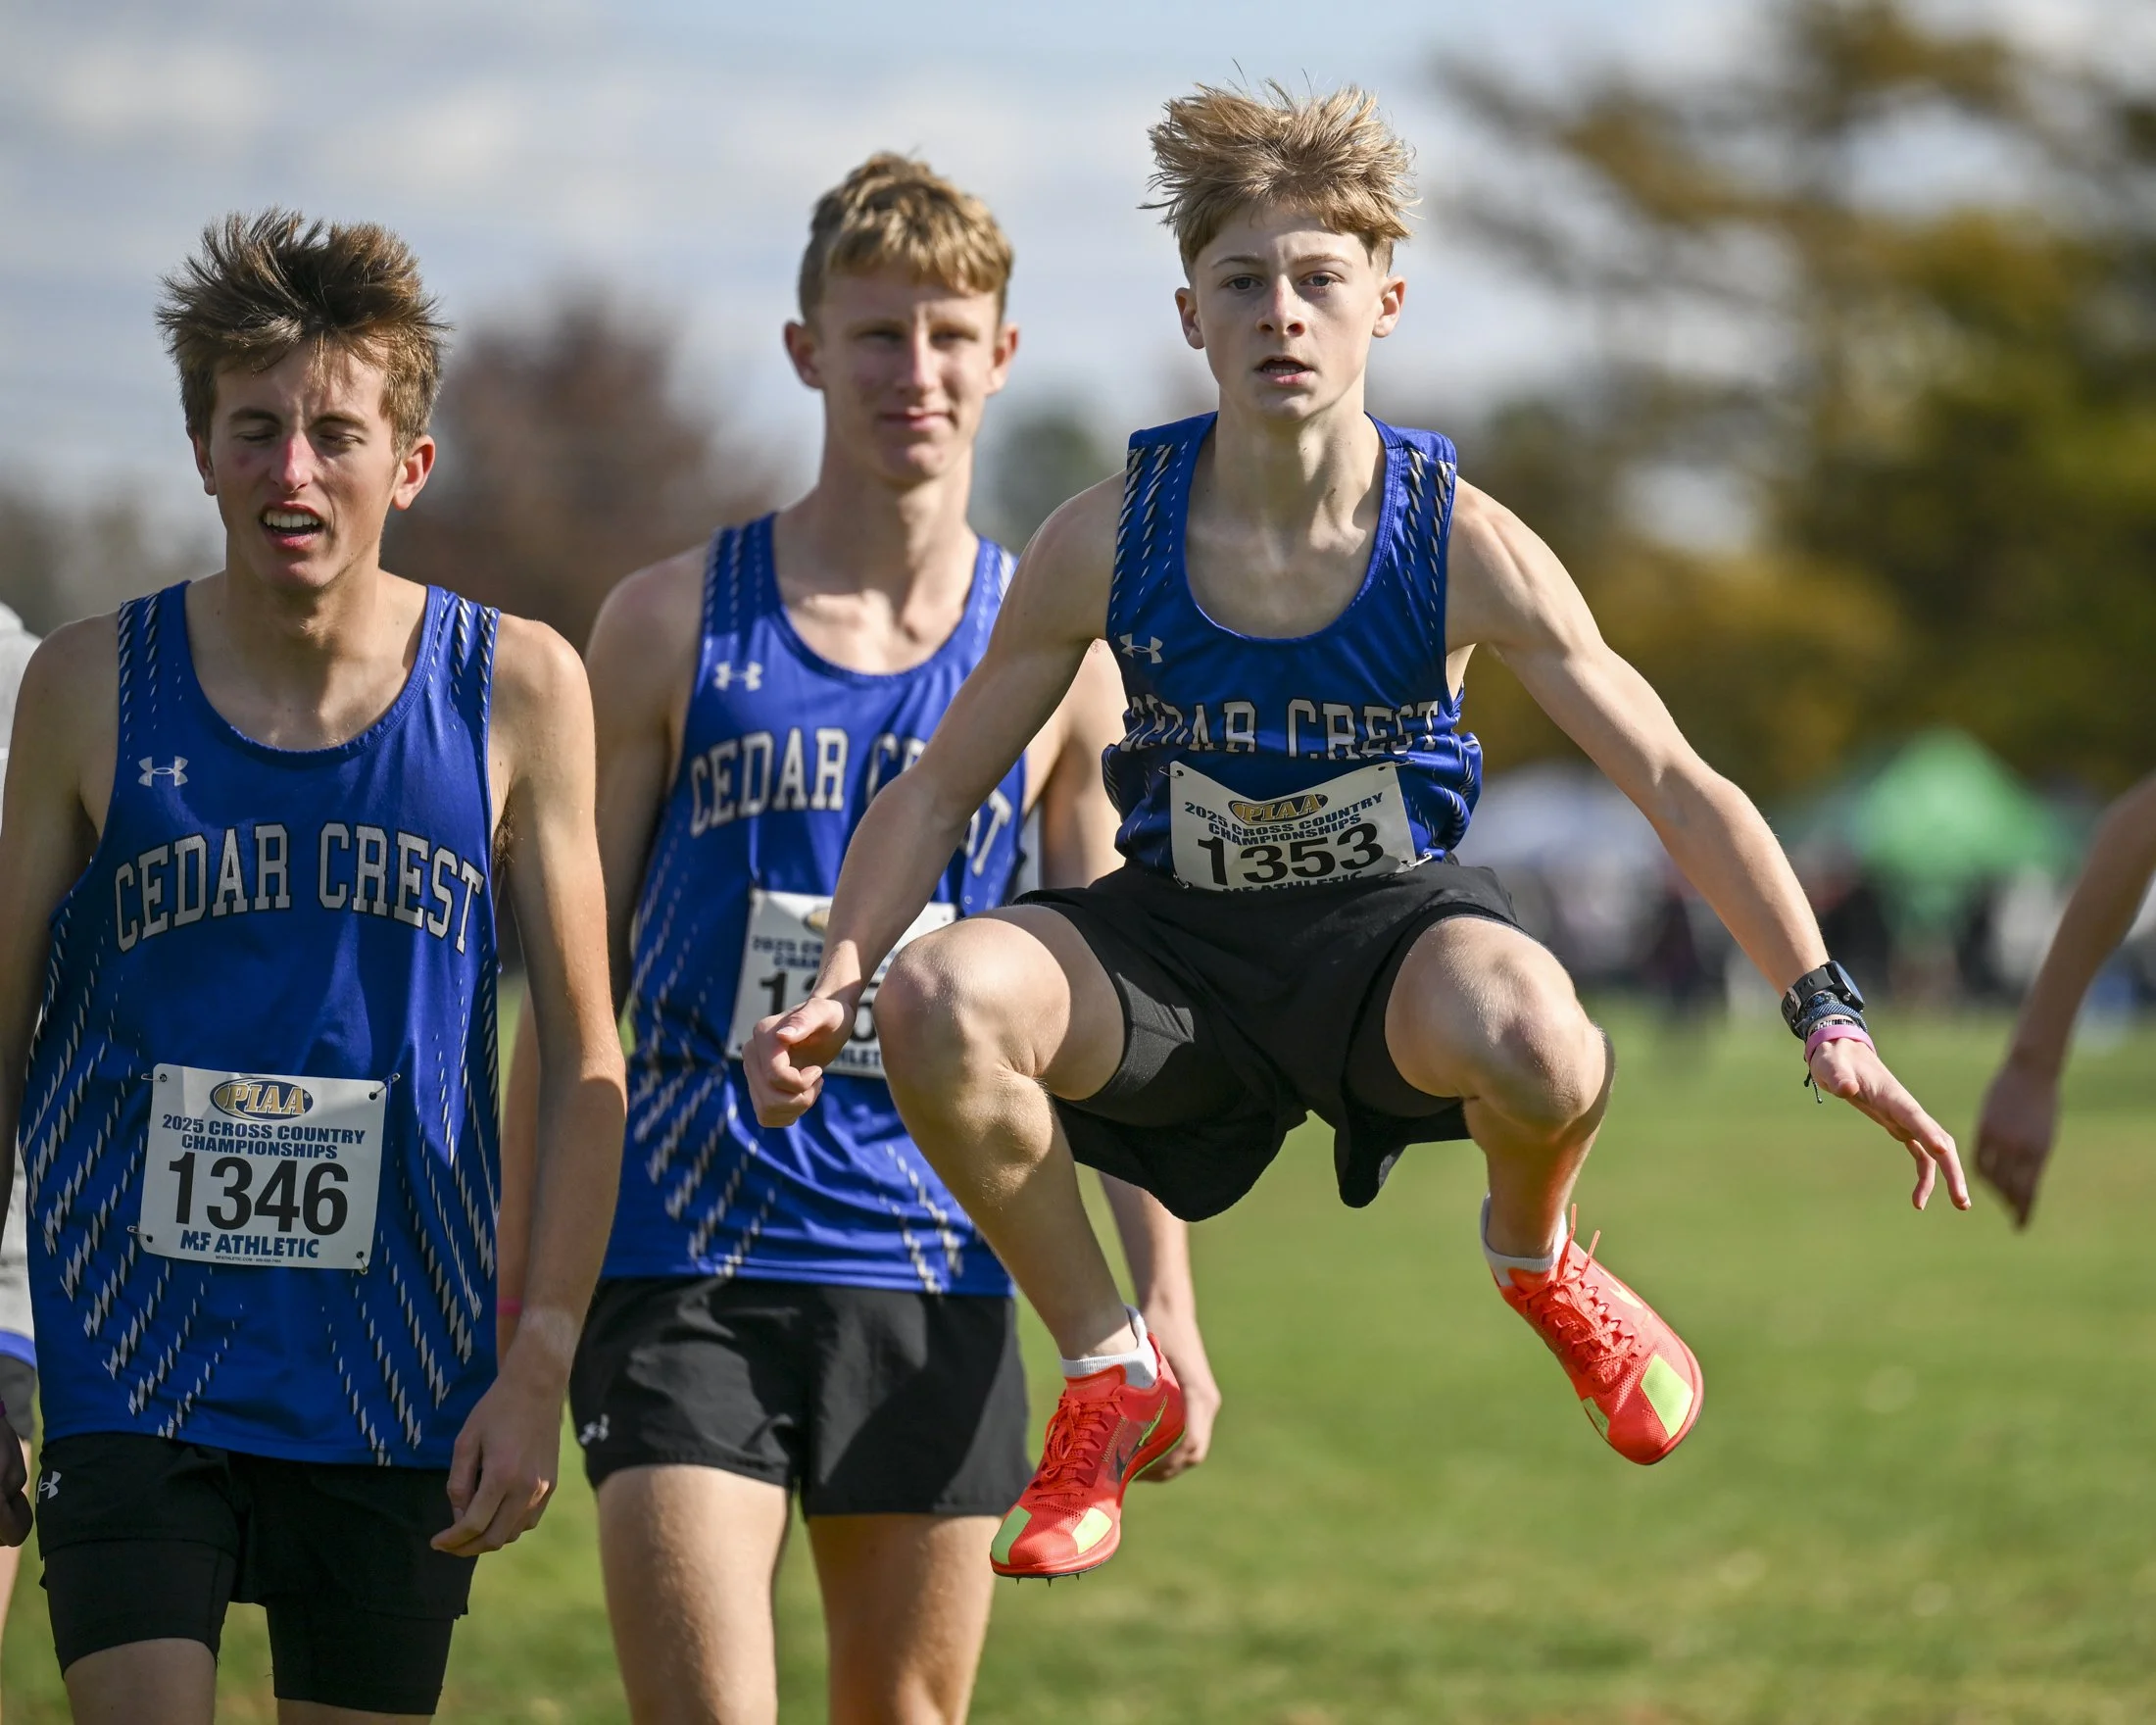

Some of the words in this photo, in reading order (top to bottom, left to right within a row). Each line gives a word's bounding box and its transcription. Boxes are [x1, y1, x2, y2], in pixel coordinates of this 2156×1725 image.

[1287, 698, 1439, 761] CREST
[689, 726, 849, 838] CEDAR
[1184, 801, 1228, 828] 2025
[1231, 822, 1297, 836] CROSS
[1298, 792, 1384, 829] COUNTRY
[1241, 794, 1321, 822] PIAA
[1208, 813, 1362, 846] CHAMPIONSHIPS
[1197, 822, 1384, 886] 1353
[113, 822, 291, 953] CEDAR
[318, 821, 485, 956] CREST
[222, 1083, 306, 1114] PIAA
[162, 1113, 204, 1133] 2025
[208, 1120, 273, 1140] CROSS
[276, 1124, 366, 1145] COUNTRY
[181, 1134, 338, 1159] CHAMPIONSHIPS
[169, 1152, 349, 1236] 1346
[214, 1233, 319, 1258] ATHLETIC
